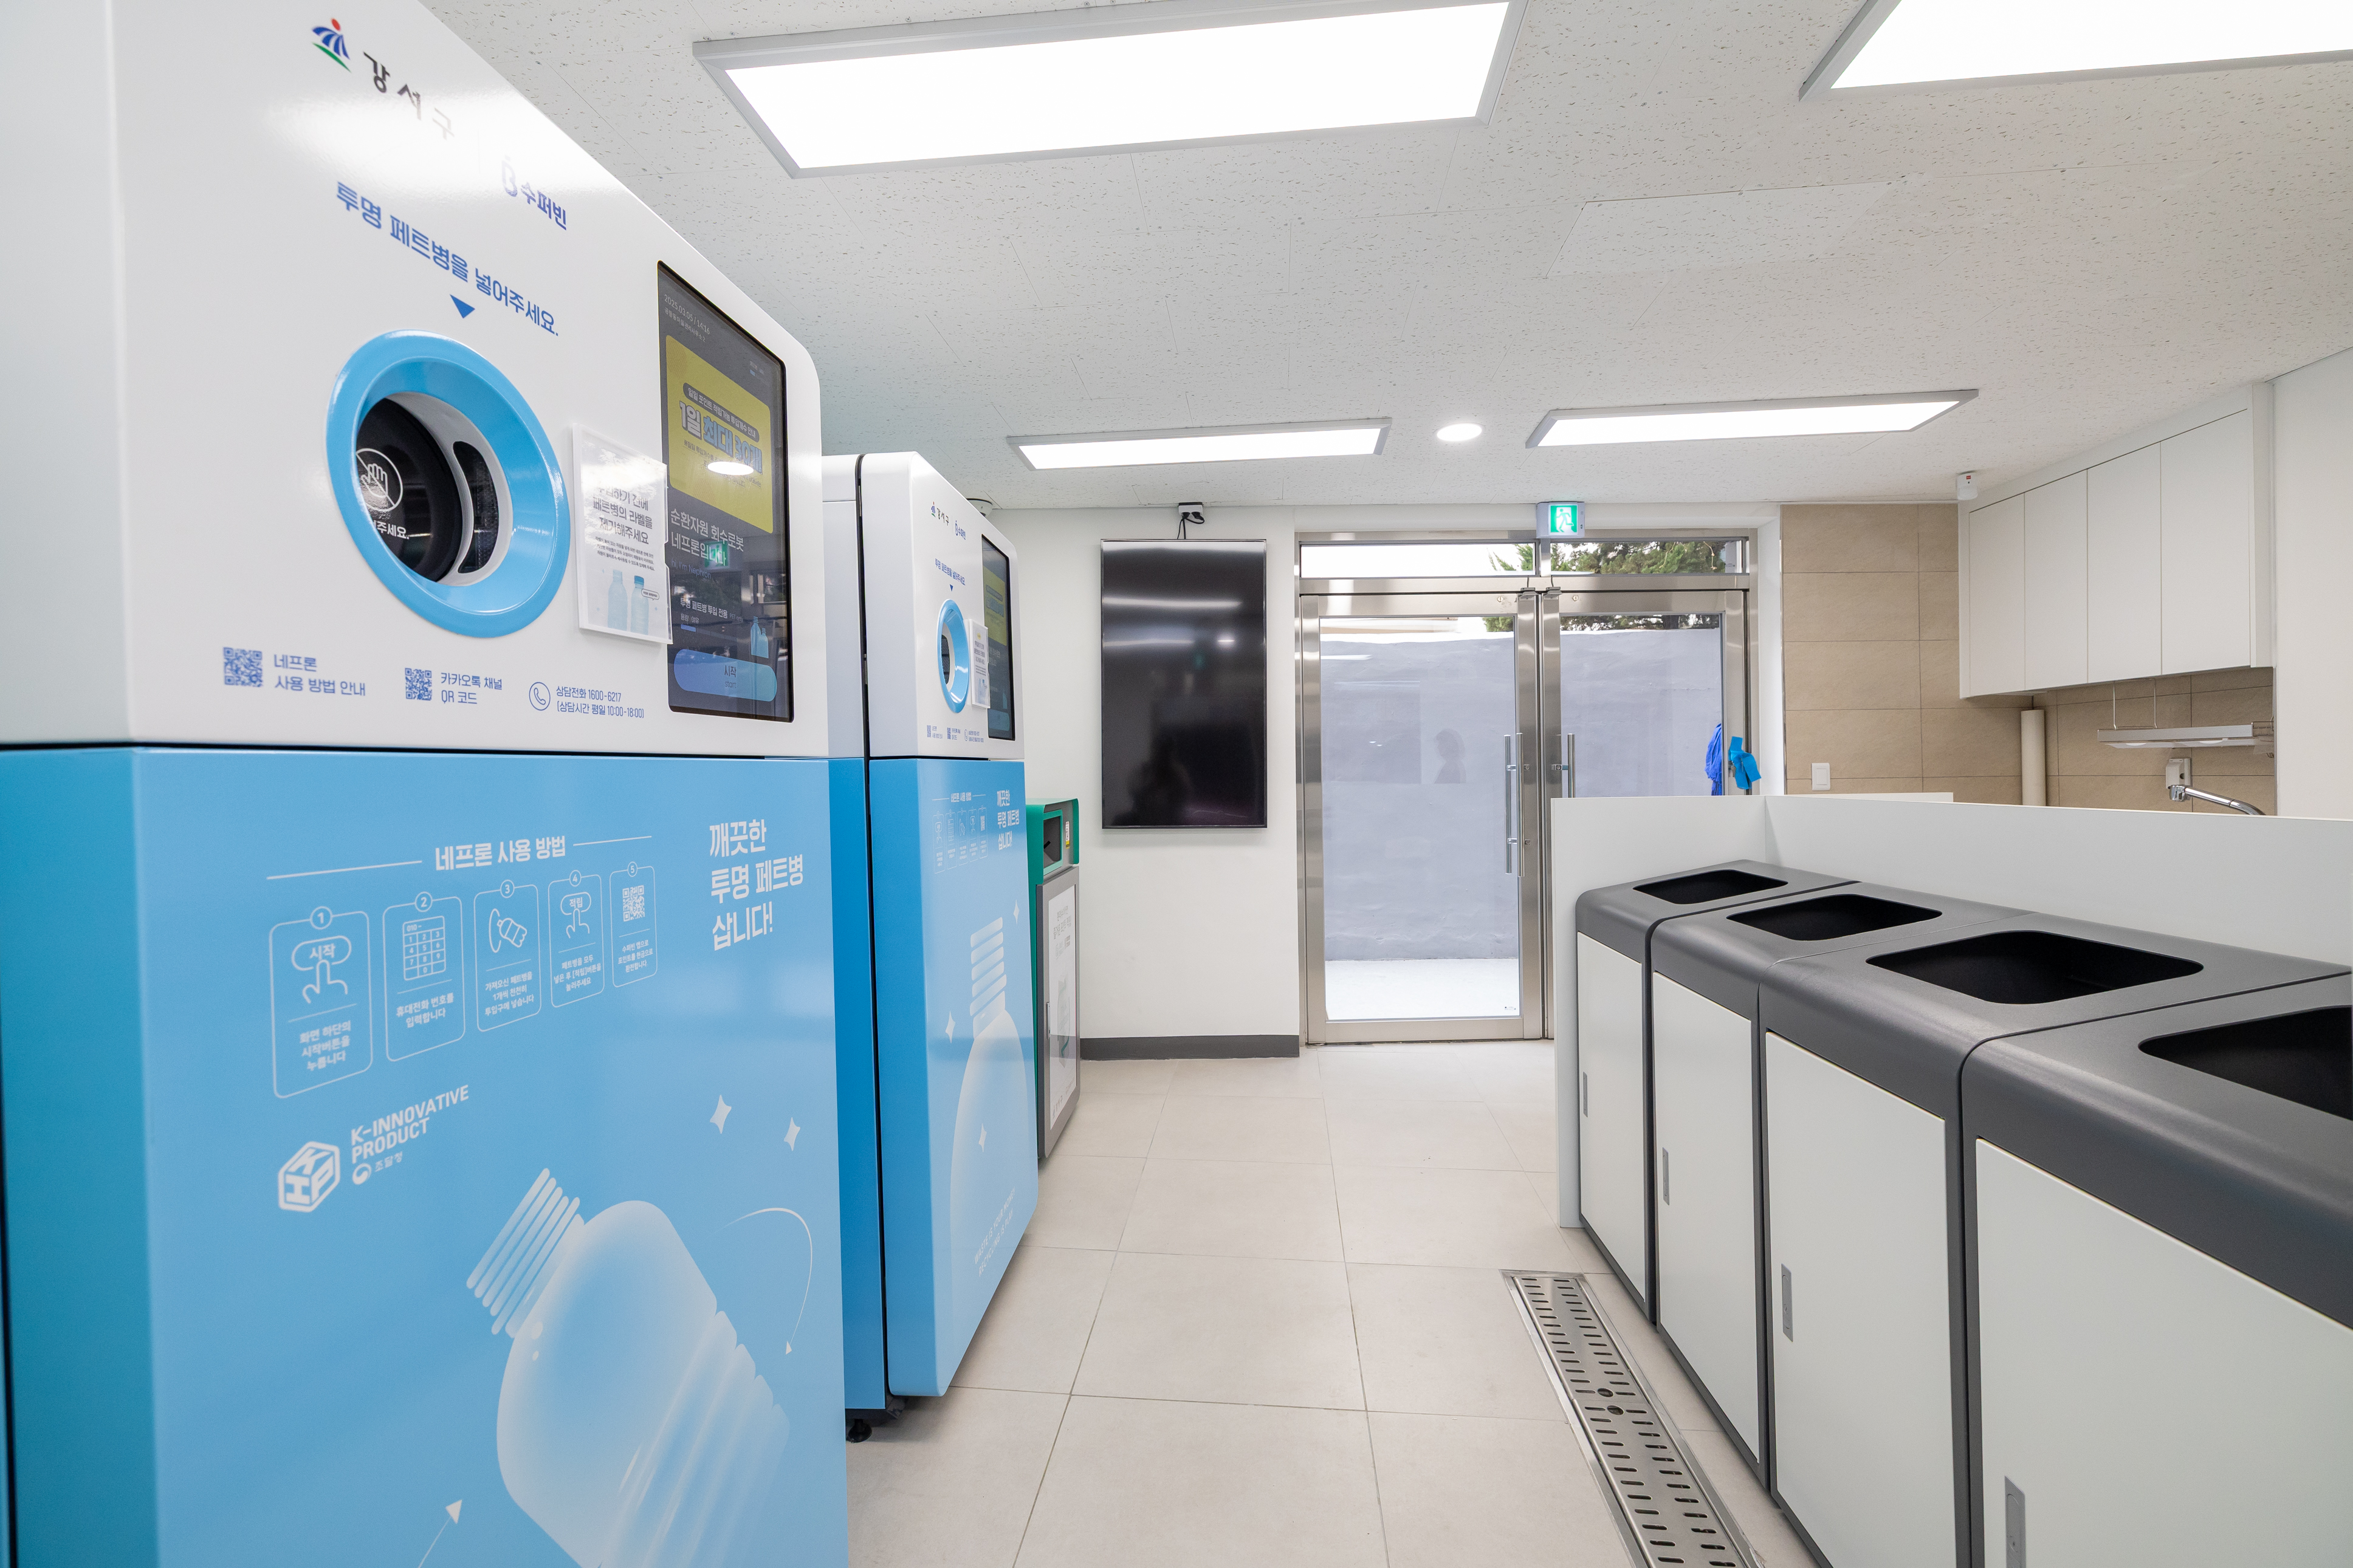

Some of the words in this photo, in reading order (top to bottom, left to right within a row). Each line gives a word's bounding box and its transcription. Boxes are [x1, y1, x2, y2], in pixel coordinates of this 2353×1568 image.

[363, 52, 455, 140] 강서구
[520, 182, 567, 230] 수퍼빈
[337, 181, 382, 229] 투명
[390, 214, 468, 282] 페트병을
[475, 267, 558, 337] 넣어주세요.
[664, 294, 693, 322] 2025.03.05
[697, 320, 710, 335] 14:16
[688, 388, 698, 402] 일일
[699, 394, 712, 411] 포인트
[713, 403, 730, 422] 적립가능
[747, 426, 756, 439] 안내
[679, 401, 702, 440] 1일
[703, 416, 733, 458] 최대
[735, 435, 763, 475] 30개
[593, 496, 627, 520] 페트병의
[629, 510, 653, 529] 라벨을
[633, 494, 648, 511] 전에
[599, 517, 649, 544] 제거해주세요
[670, 508, 709, 538] 순환자원
[711, 524, 744, 552] 회수로봇
[671, 531, 726, 567] 네프론입니다
[689, 564, 711, 579] Nephron
[692, 601, 707, 613] 페트병
[708, 604, 718, 616] 투입
[718, 608, 728, 619] 전용
[273, 655, 318, 673] 네프론
[724, 665, 737, 678] 시작
[275, 676, 305, 693] 사용
[308, 677, 337, 695] 방법
[340, 679, 366, 697] 안내
[441, 672, 481, 688] 카카오톡
[484, 676, 503, 691] 채널
[441, 690, 455, 705] QR
[458, 691, 478, 705] 코드
[556, 685, 586, 700] 상담전화
[588, 690, 622, 702] 1600-6217
[591, 703, 605, 716] 평일
[709, 819, 767, 857] 깨끗한
[435, 844, 493, 871] 네프론
[497, 839, 531, 864] 사용
[535, 835, 566, 860] 방법
[711, 863, 749, 904] 투명
[755, 854, 803, 893] 페트병
[569, 897, 583, 909] 적립
[712, 901, 773, 951] 삽니다!
[309, 942, 336, 960] 시작
[617, 953, 636, 964] 포인트를
[636, 948, 653, 959] 현금으로
[622, 943, 635, 953] 수퍼빈
[636, 939, 649, 950] 앱으로
[562, 957, 582, 970] 페트병을
[583, 954, 594, 964] 모두
[625, 959, 647, 973] 환전합니다
[485, 977, 509, 991] 가져오신
[510, 971, 532, 984] 페트병을
[554, 973, 565, 984] 넣은
[566, 971, 571, 980] 후
[566, 977, 591, 991] 눌러주세요
[492, 990, 509, 1001] 1개씩
[510, 984, 527, 997] 천천히
[396, 999, 429, 1018] 휴대전화
[431, 992, 455, 1008] 번호를
[485, 1001, 510, 1016] 투입구에
[511, 994, 534, 1008] 넣습니다
[322, 1020, 351, 1036] 하단의
[405, 1007, 446, 1028] 입력합니다
[301, 1035, 350, 1057] 시작버튼을
[351, 1084, 469, 1146] K-INNOVATIVE
[352, 1117, 430, 1164] PRODUCT
[374, 1151, 403, 1173] 조달청
[974, 1234, 988, 1265] WASTE
[989, 1227, 992, 1240] IS
[993, 1208, 1003, 1230] YOUR
[1003, 1186, 1015, 1213] MONEY
[978, 1233, 1000, 1277] RECYCLING
[1000, 1225, 1005, 1236] IS
[1005, 1208, 1013, 1228] PLAY
